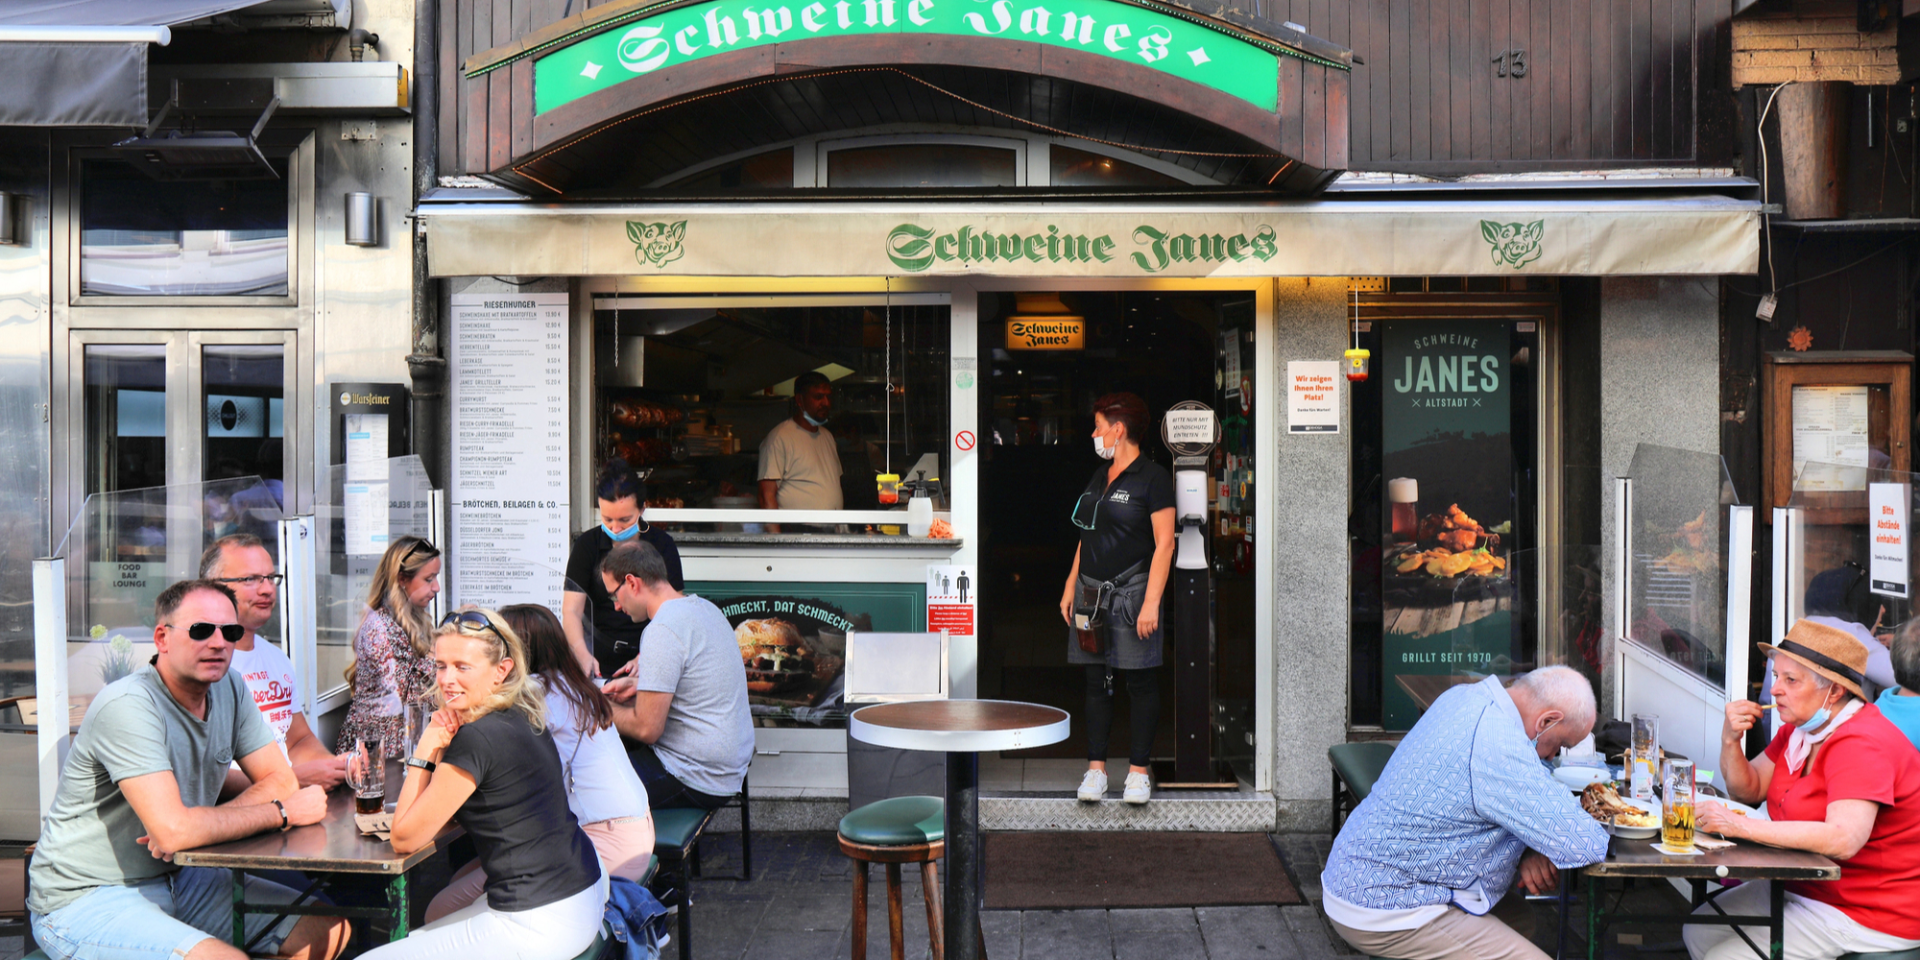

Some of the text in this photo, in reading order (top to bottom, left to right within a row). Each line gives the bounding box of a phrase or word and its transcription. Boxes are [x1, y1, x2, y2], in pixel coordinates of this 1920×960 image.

[617, 0, 1172, 72] Schweine Janes
[1492, 48, 1527, 78] 13
[885, 223, 1279, 273] Schweine Janes
[1011, 322, 1079, 336] Schweine
[1026, 334, 1069, 348] Janes
[1414, 333, 1478, 350] SCHWEINE
[1310, 375, 1332, 384] zeigen
[1394, 355, 1499, 393] JANES
[352, 392, 390, 406] Warsteiner
[1426, 398, 1468, 407] ALTSTADT
[463, 499, 501, 509] BRÖTCHEN,
[503, 500, 536, 508] BEILAGEN
[546, 501, 558, 509] CO.
[1882, 505, 1894, 516] Bitte
[1877, 519, 1900, 530] Abstände
[1876, 533, 1902, 545] einhalten!
[113, 580, 146, 588] LOUNGE
[774, 600, 795, 613] DAT
[797, 603, 854, 633] SCHMECKT
[1402, 652, 1491, 663] GRILLT SEIT 1970
[242, 671, 270, 682] VINTAGE
